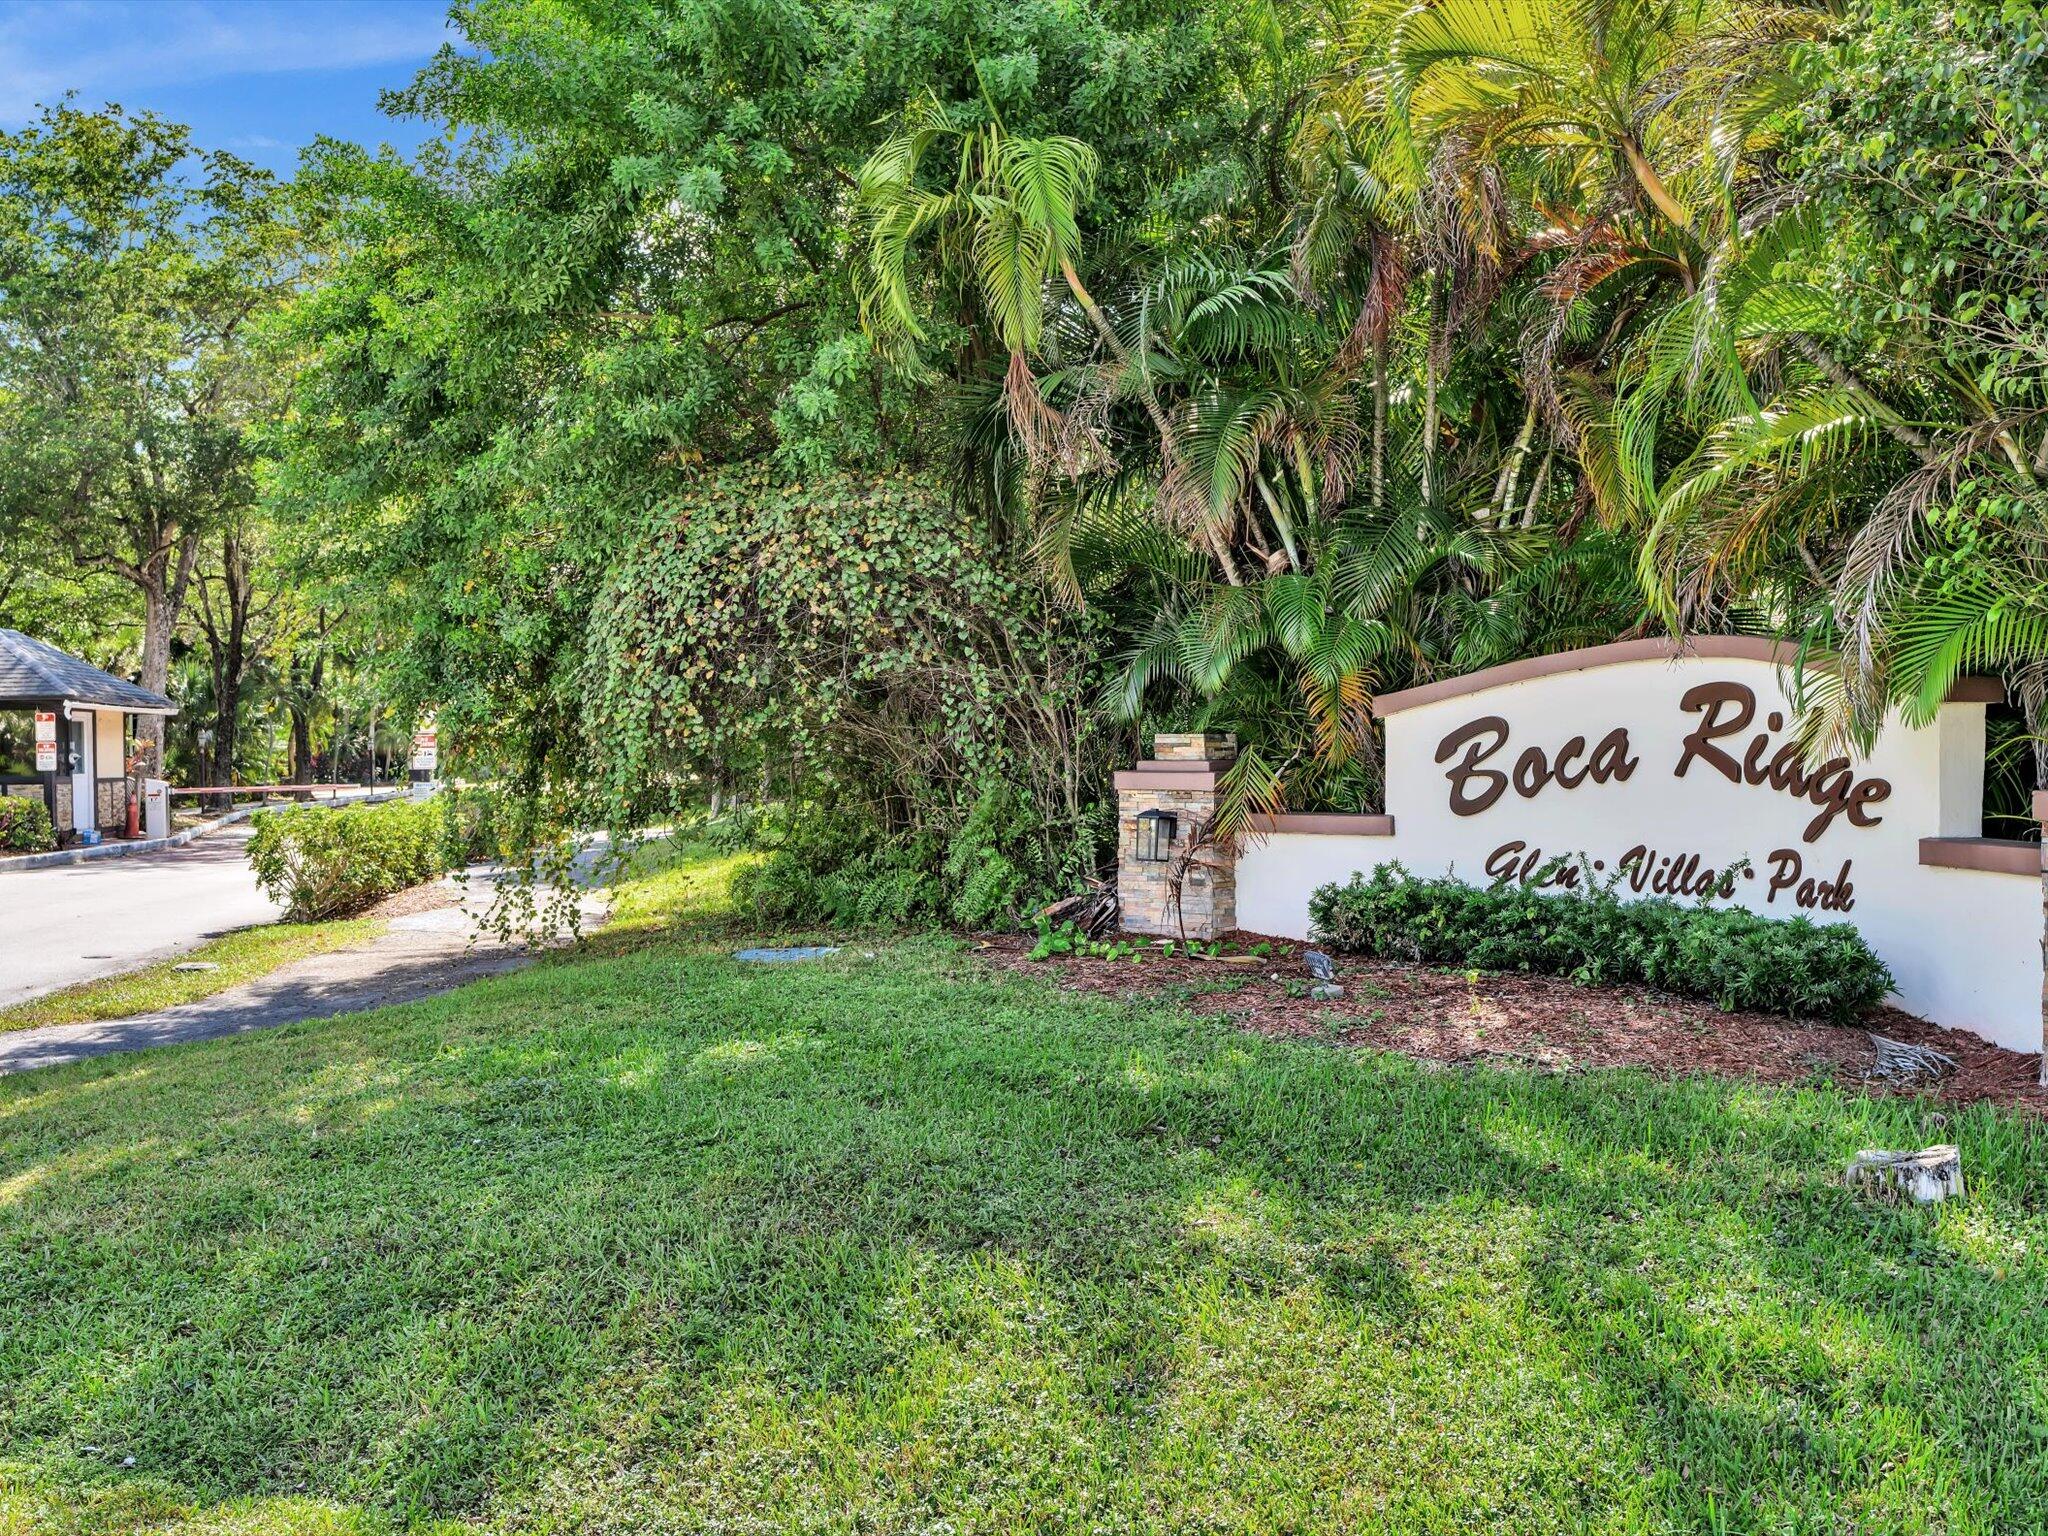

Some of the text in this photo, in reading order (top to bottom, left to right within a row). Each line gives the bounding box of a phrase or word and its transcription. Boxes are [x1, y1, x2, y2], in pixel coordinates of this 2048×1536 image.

[1435, 681, 1892, 843] Boca Ridge
[1767, 848, 1855, 913] Park
